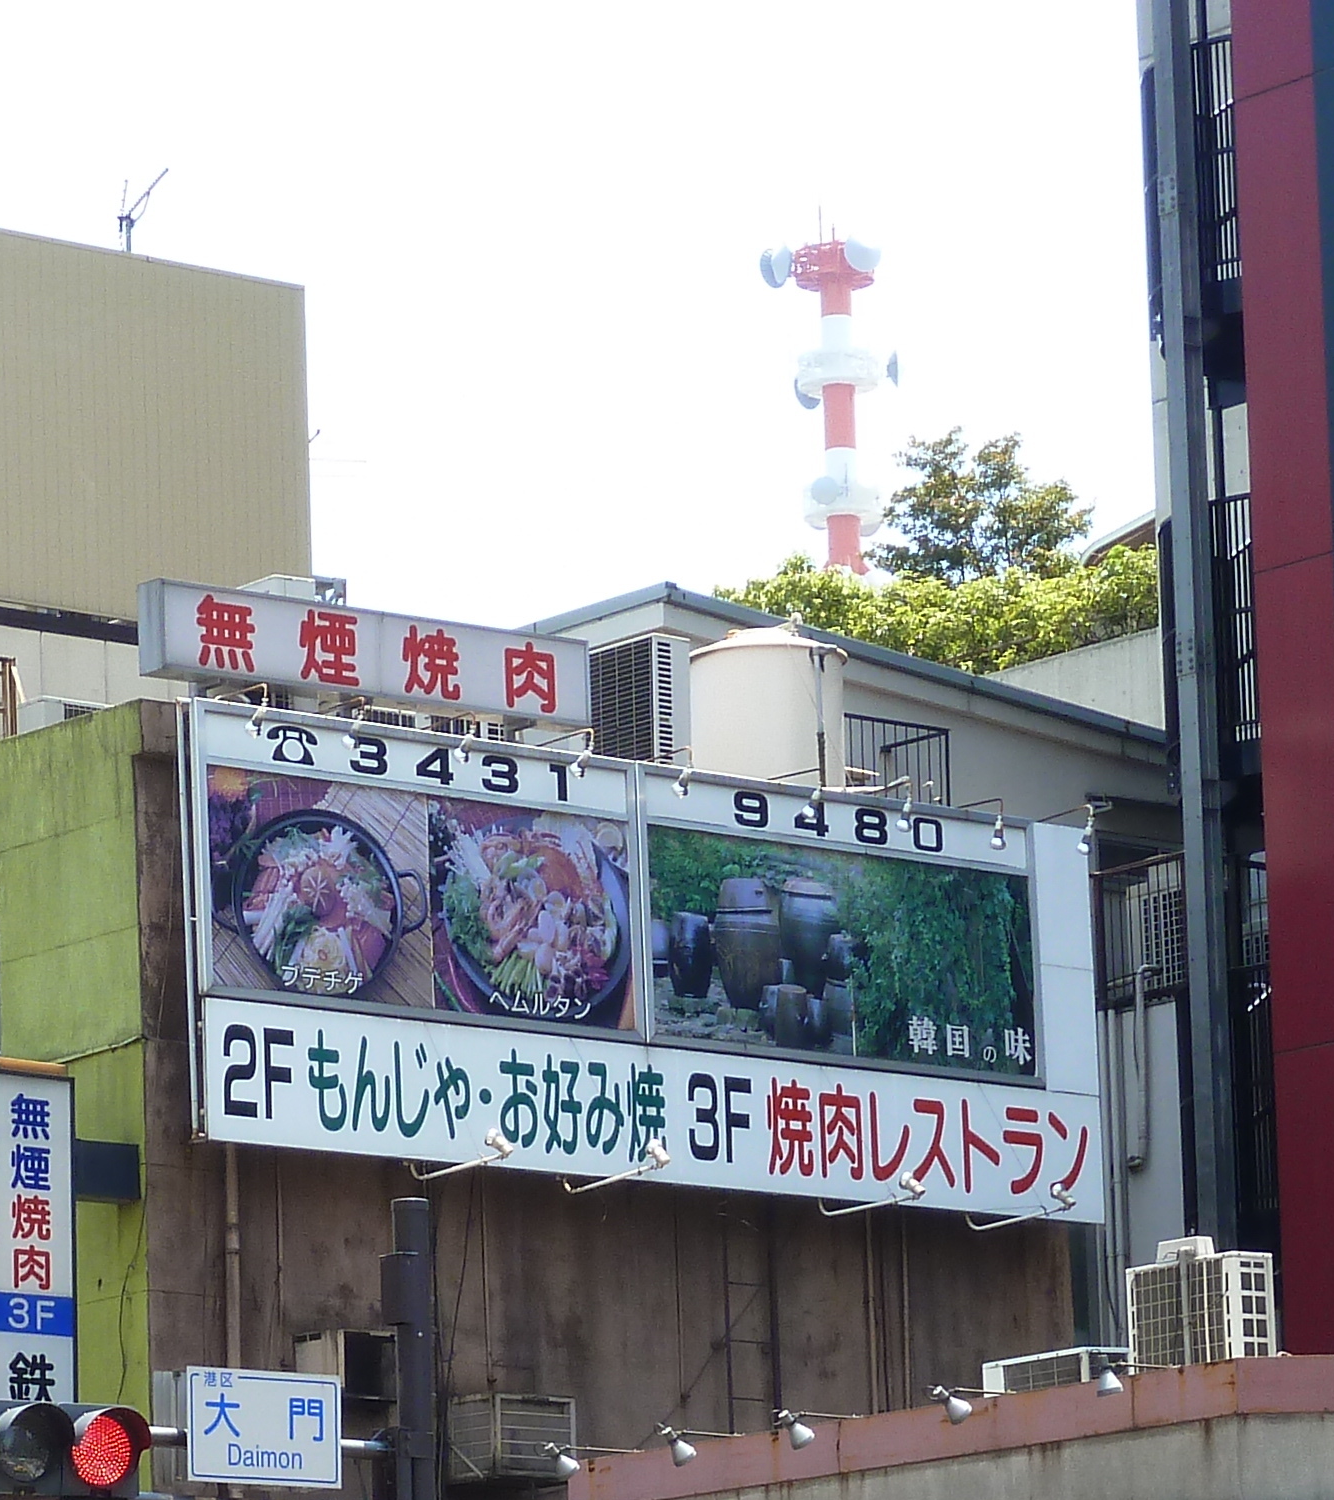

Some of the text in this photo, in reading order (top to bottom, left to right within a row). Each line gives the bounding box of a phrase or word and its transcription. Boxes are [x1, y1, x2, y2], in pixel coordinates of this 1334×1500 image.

[197, 594, 559, 714] 無煙焼肉
[349, 735, 944, 855] 3431 9480
[489, 990, 592, 1021] ヘムルタン
[907, 1015, 1033, 1067] 韓国の味
[222, 1023, 1089, 1197] 2F もんじゃ・お好み焼 3F 焼肉レストラン
[9, 1092, 53, 1292] 無煙焼肉
[6, 1297, 55, 1331] 3F
[203, 1371, 234, 1388] 港区
[203, 1392, 324, 1442] 大門
[227, 1443, 303, 1470] Daimon
